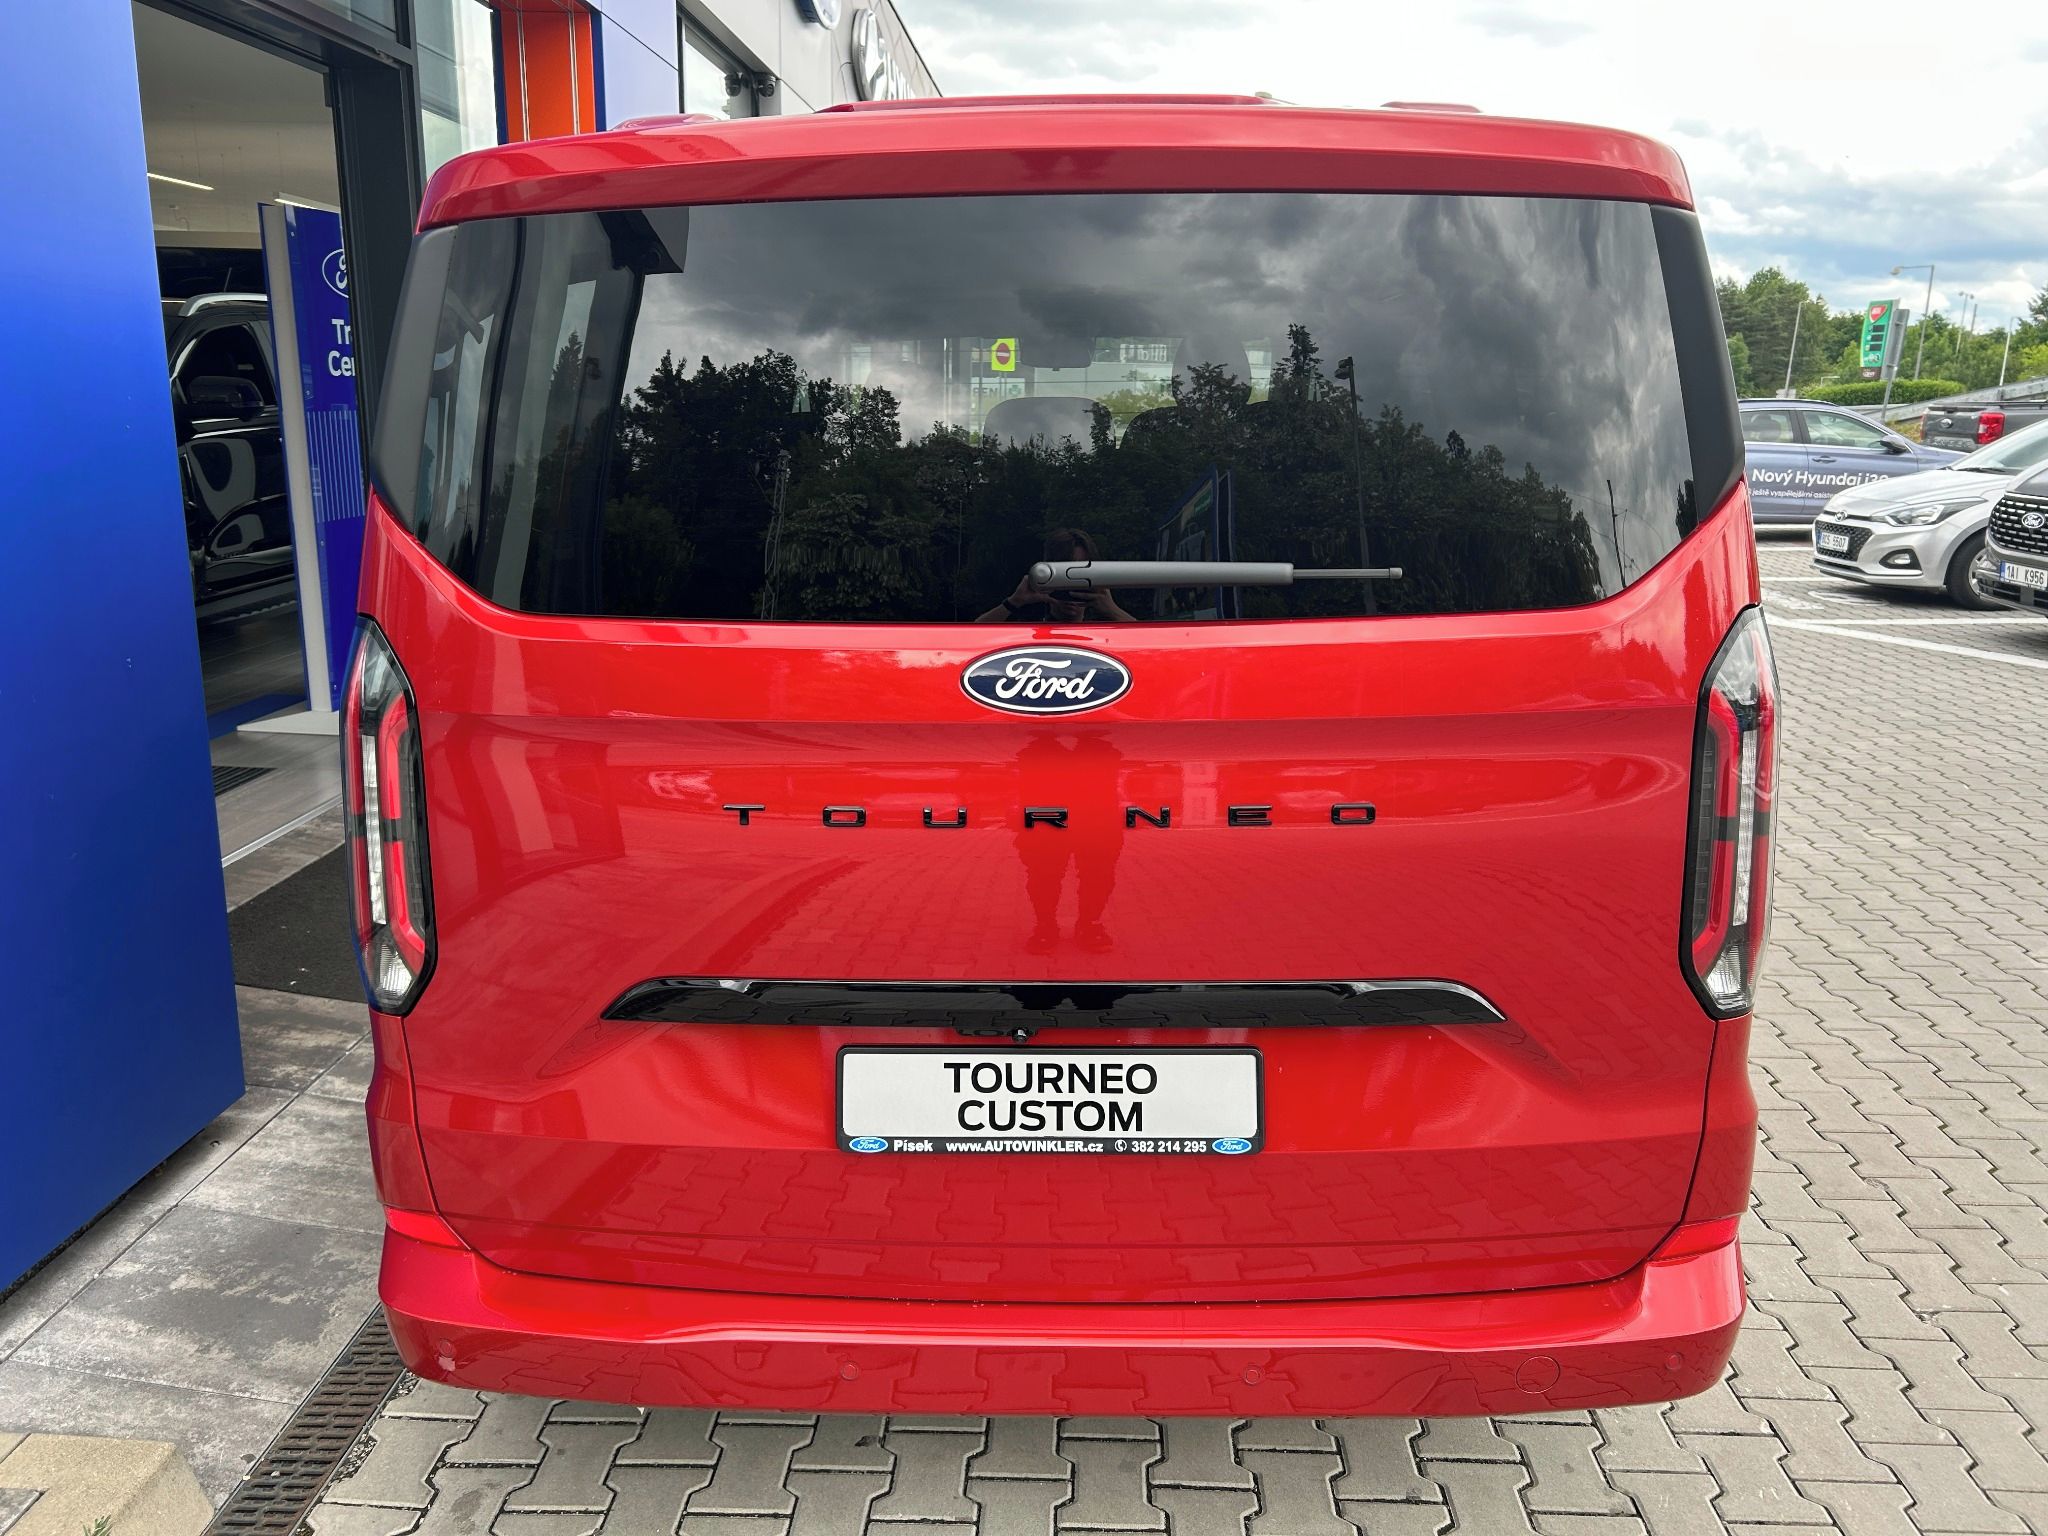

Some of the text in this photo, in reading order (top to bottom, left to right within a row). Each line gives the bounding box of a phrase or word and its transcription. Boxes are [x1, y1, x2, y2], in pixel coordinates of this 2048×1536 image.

[1752, 468, 1793, 486] Nový
[1795, 470, 1862, 487] Hyundai
[2025, 568, 2045, 585] K956
[995, 657, 1098, 700] Ford
[722, 803, 1377, 829] TOURNEO
[943, 1062, 1158, 1094] TOURNEO
[957, 1099, 1143, 1132] CUSTOM
[893, 1139, 934, 1153] Písek
[946, 1139, 1104, 1153] www.AUTOVINKLER.cz
[1131, 1140, 1155, 1153] 382
[1157, 1140, 1181, 1153] 214
[1184, 1140, 1207, 1153] 295
